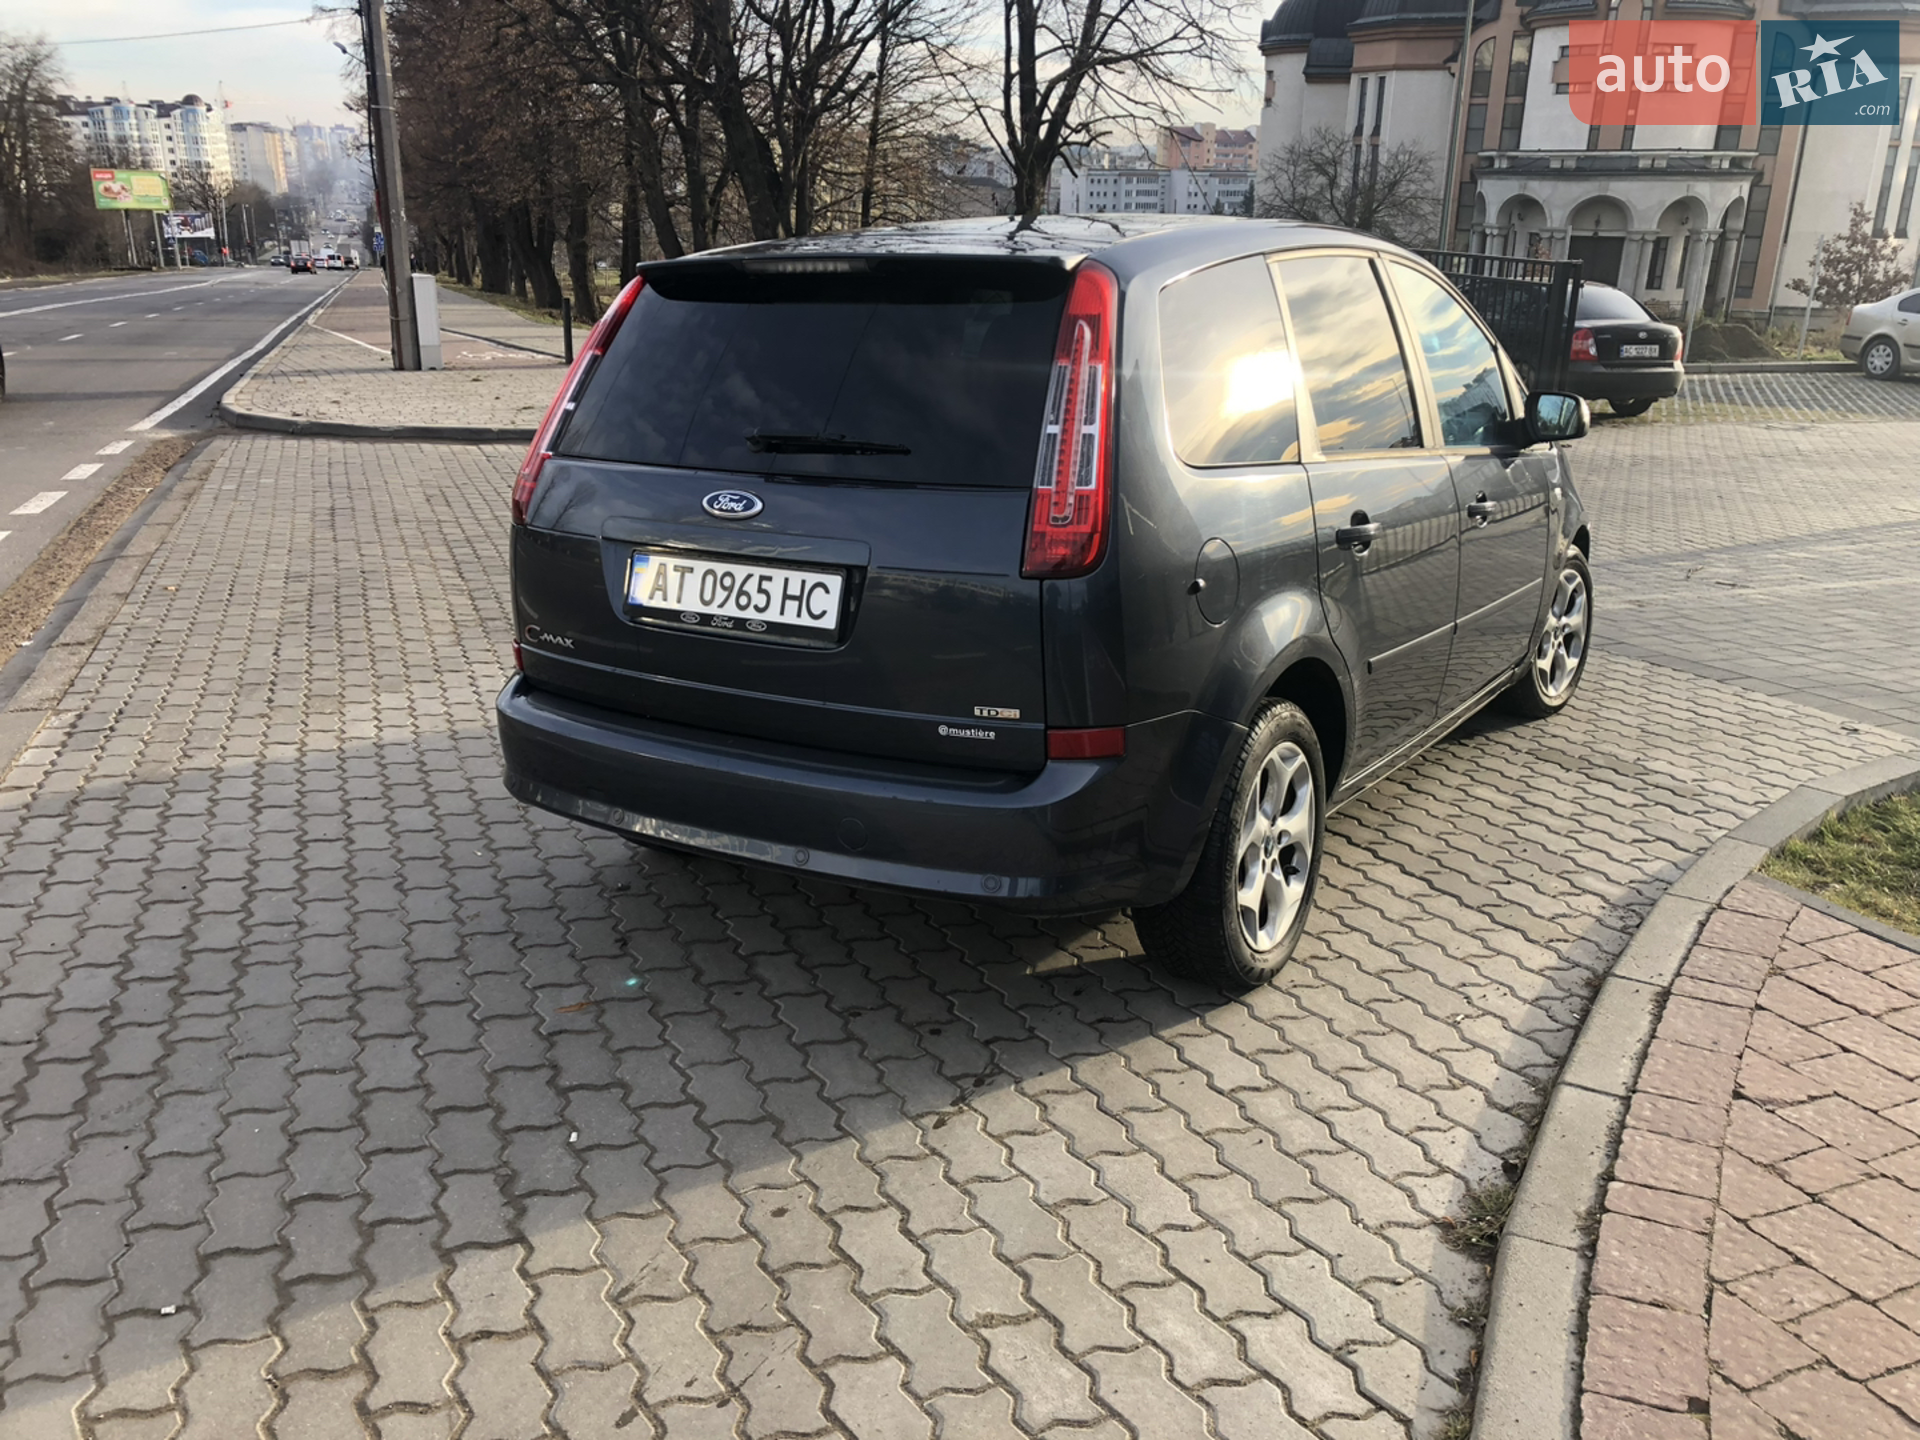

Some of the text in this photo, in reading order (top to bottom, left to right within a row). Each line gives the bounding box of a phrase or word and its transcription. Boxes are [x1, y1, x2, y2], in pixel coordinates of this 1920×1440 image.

[713, 493, 748, 512] Ford
[648, 562, 831, 621] AT 0965 HC
[710, 614, 735, 629] Ford
[938, 724, 996, 739] @mustière
